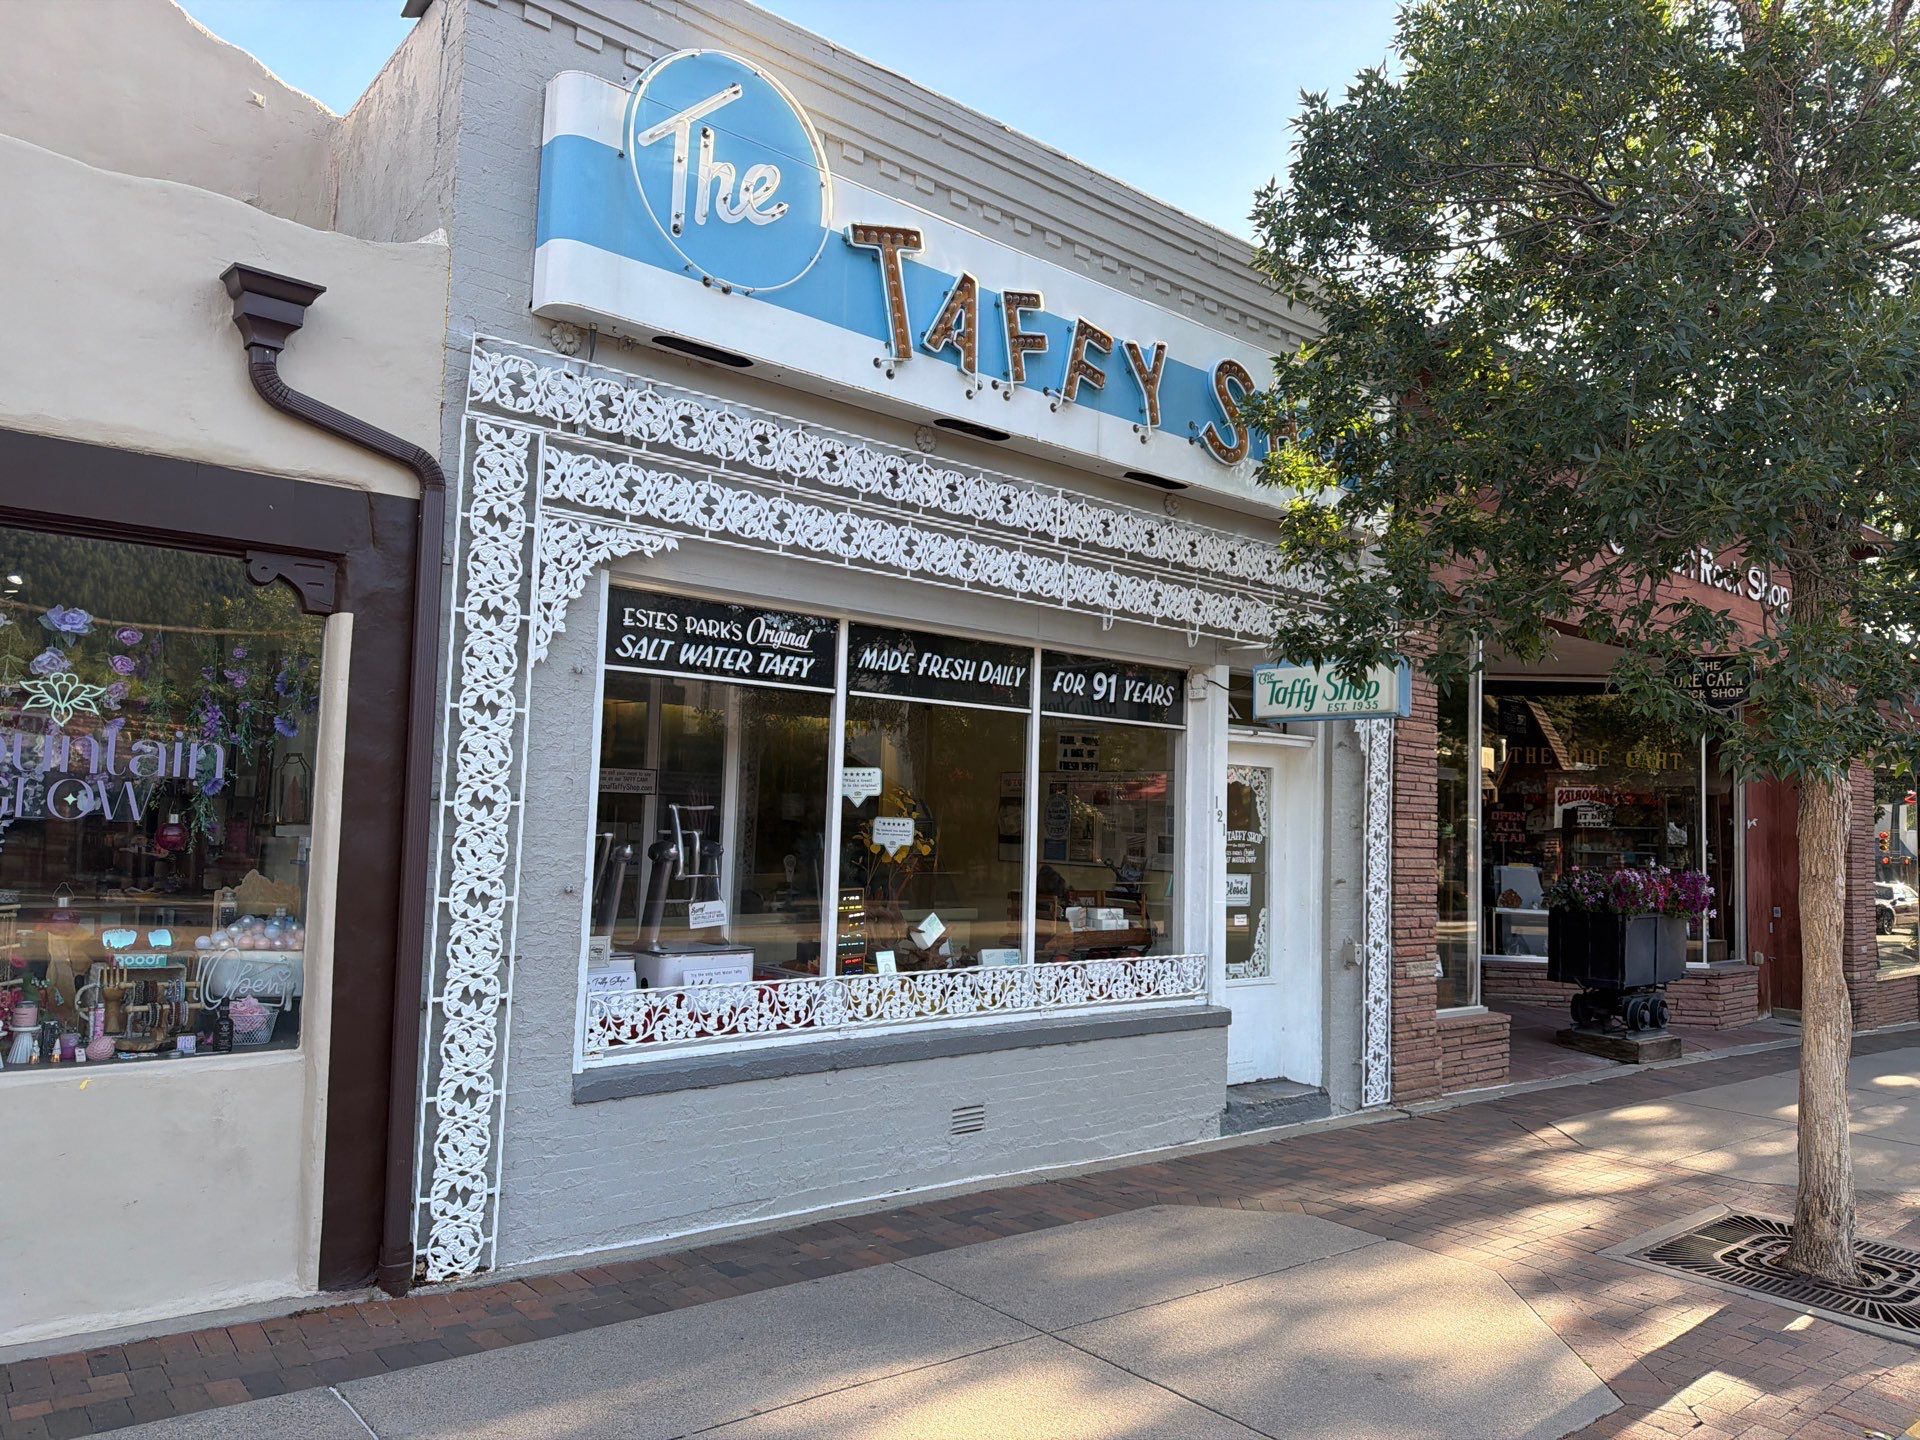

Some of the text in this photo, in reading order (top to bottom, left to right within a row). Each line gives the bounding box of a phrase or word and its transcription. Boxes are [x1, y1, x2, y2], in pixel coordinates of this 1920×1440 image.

[637, 82, 790, 238] The
[843, 222, 1169, 428] TAFFY
[622, 607, 813, 653] ESTES PARK'S Original
[615, 633, 816, 679] SALT WATER TAFFY
[858, 646, 1027, 688] MADE FRESH DAILY
[1052, 670, 1175, 708] FOR 91 YEARS
[1257, 671, 1276, 686] The
[1267, 678, 1319, 712] Taffy
[1322, 671, 1380, 702] Shop
[1711, 688, 1744, 698] SHOP
[1327, 700, 1379, 712] EST. 1935
[0, 729, 225, 780] untain
[1511, 746, 1552, 764] THE
[0, 776, 156, 822] LOW
[1491, 810, 1527, 822] OPEN
[1246, 831, 1263, 844] SHOP
[1490, 832, 1526, 844] YEAR
[1496, 822, 1522, 832] ALL
[200, 948, 281, 1010] Open
